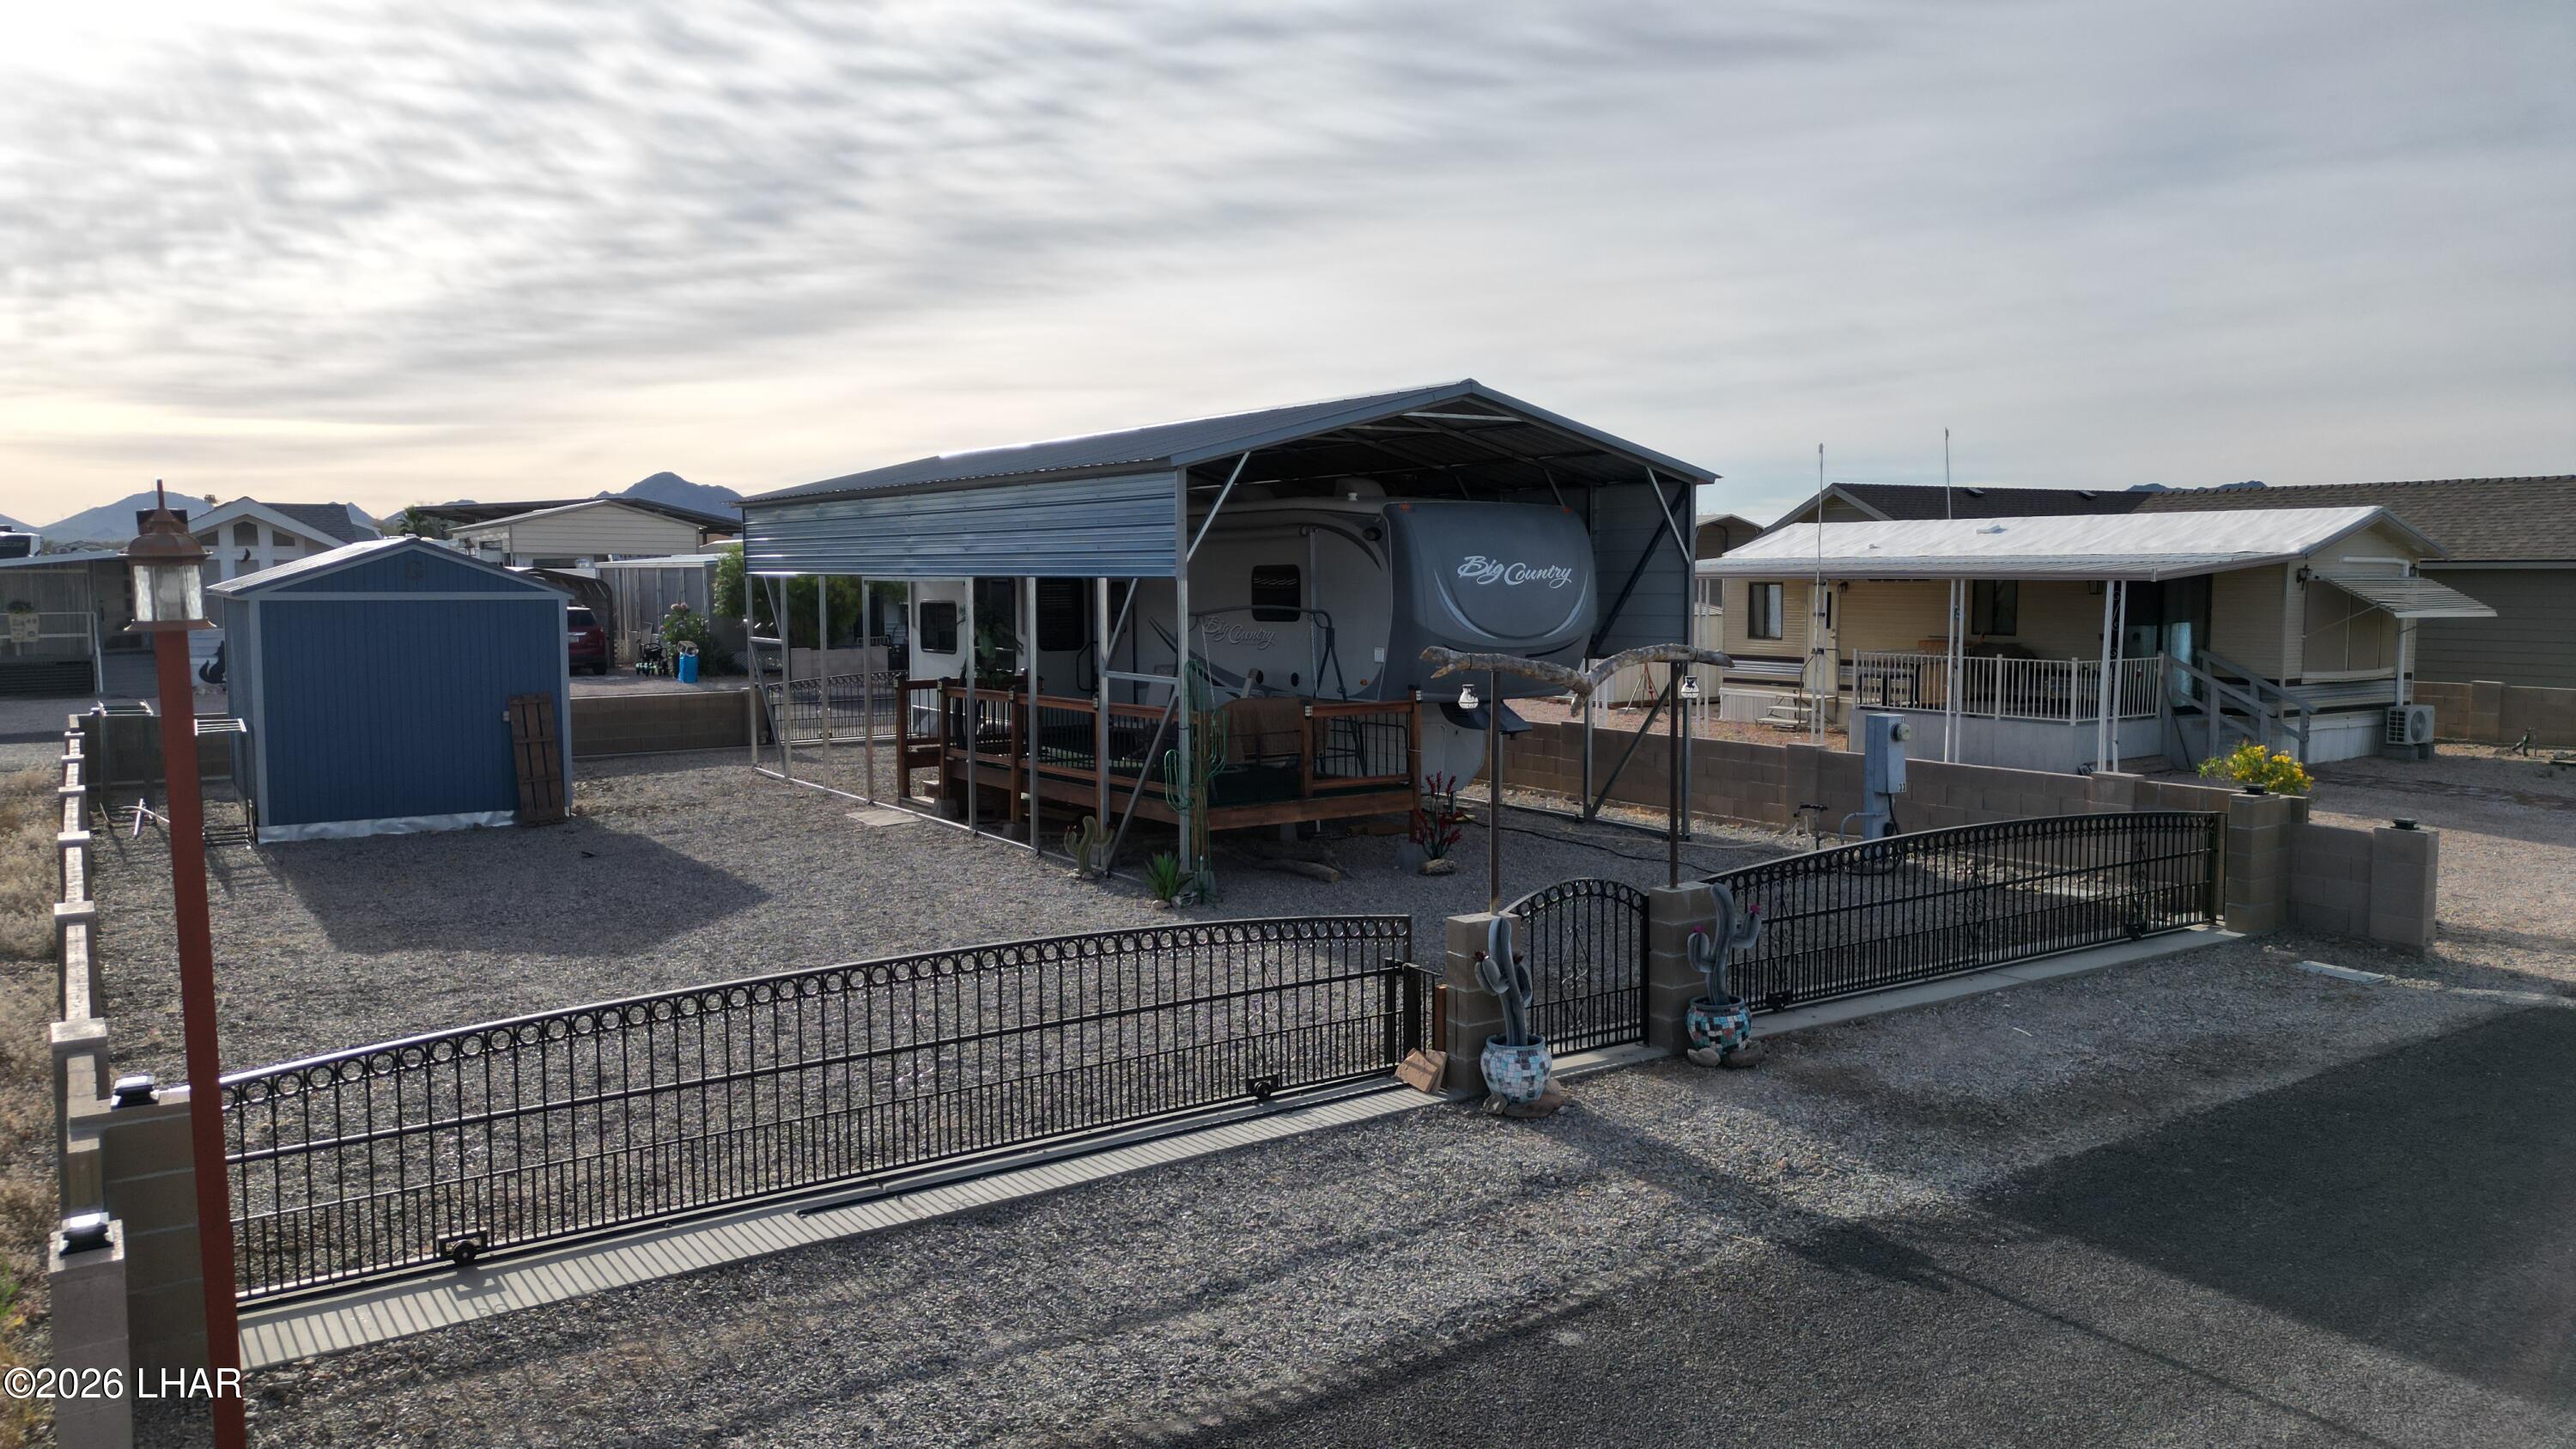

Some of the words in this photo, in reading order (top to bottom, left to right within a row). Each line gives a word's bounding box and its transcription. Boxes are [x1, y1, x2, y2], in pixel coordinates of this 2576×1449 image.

[1457, 556, 1504, 584] Big
[1504, 563, 1572, 588] Country
[1202, 616, 1230, 642] Big
[1229, 624, 1276, 649] Country
